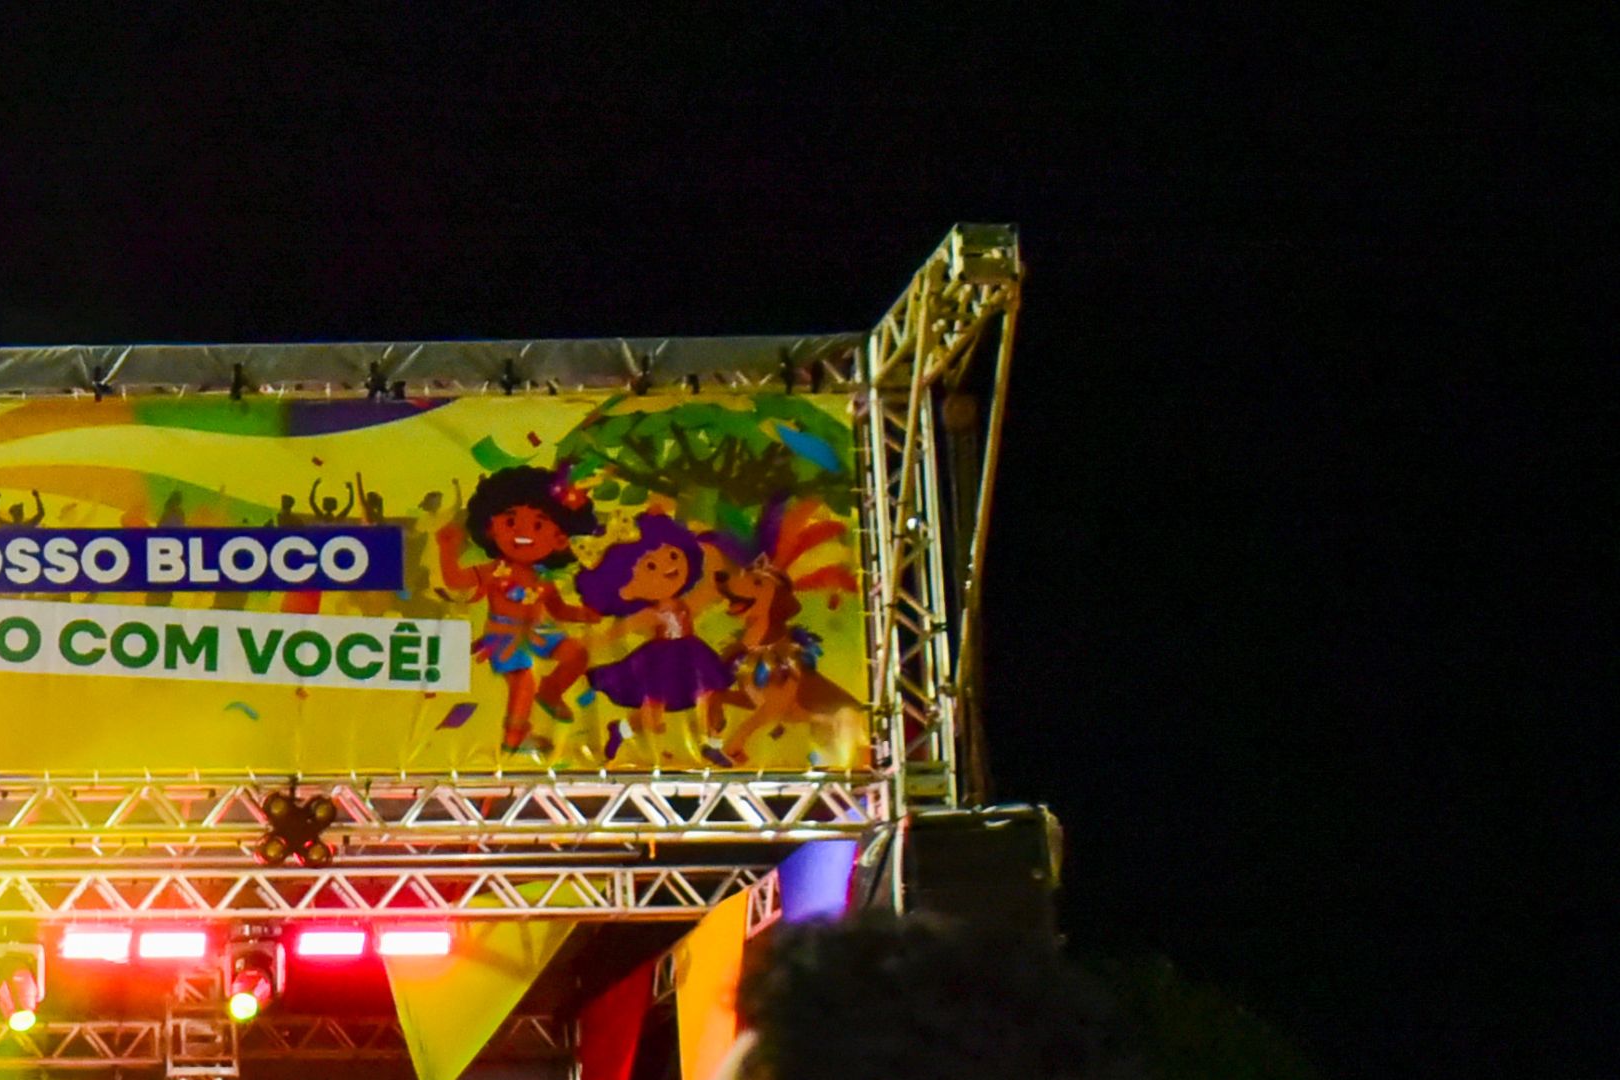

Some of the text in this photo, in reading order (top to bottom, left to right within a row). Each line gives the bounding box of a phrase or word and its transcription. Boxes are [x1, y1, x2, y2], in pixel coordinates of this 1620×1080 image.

[146, 535, 369, 584] BLOCO
[57, 619, 219, 672] COM
[237, 621, 442, 683] VOCÊ!
